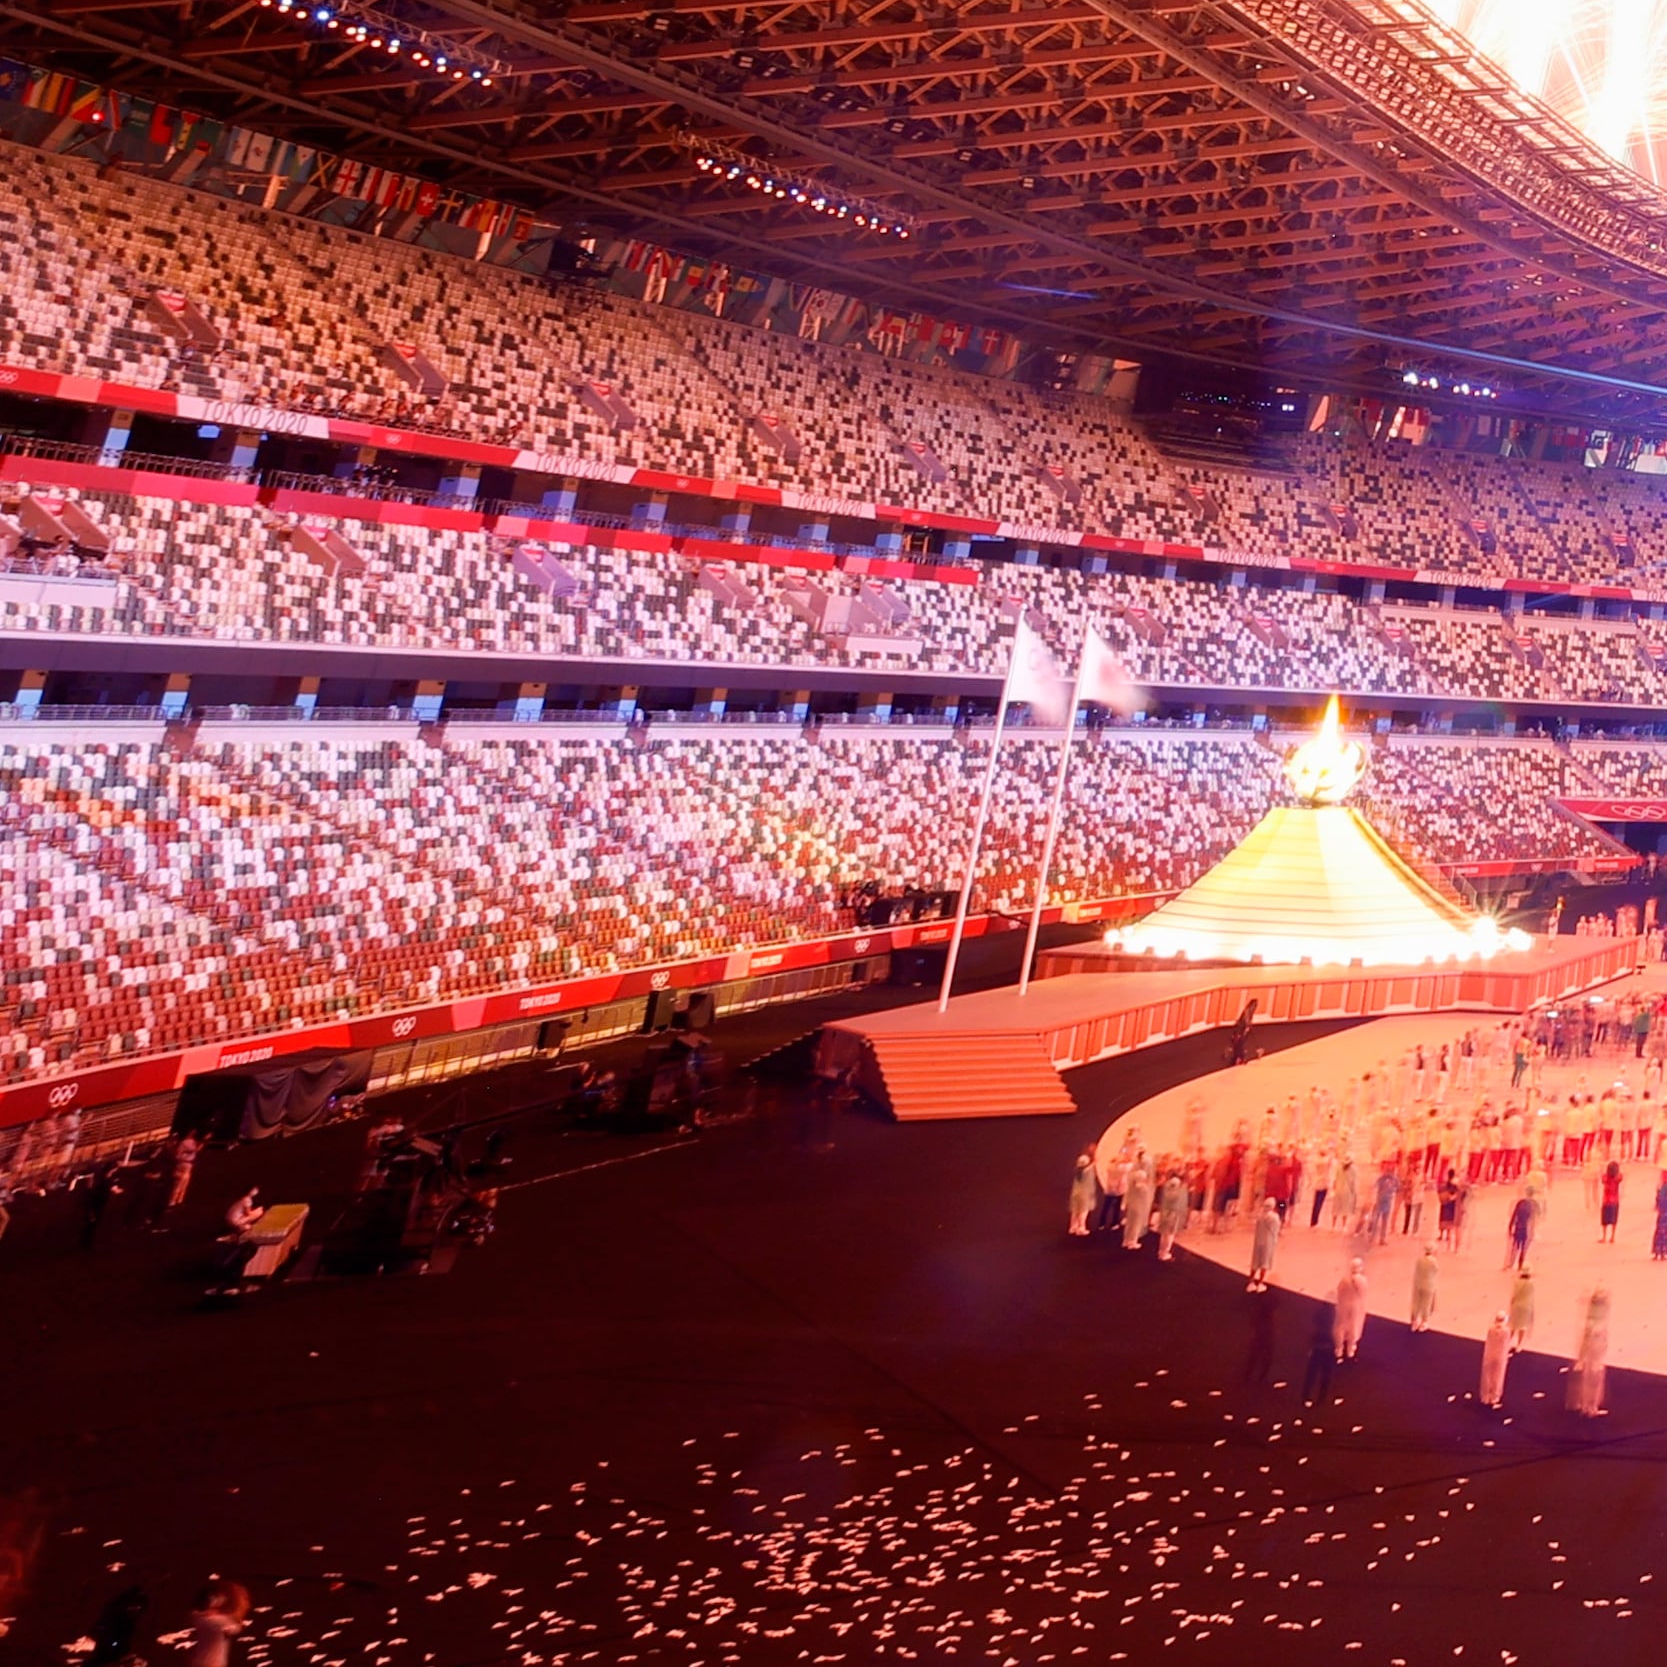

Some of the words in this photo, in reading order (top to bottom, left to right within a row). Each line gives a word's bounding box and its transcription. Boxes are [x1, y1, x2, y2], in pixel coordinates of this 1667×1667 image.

[203, 400, 260, 427] TOKYO
[263, 411, 308, 434] 2020
[536, 453, 583, 475] TOKYO
[585, 460, 617, 481] 2020
[220, 1050, 249, 1067] TOKYO
[250, 1046, 273, 1062] 2020
